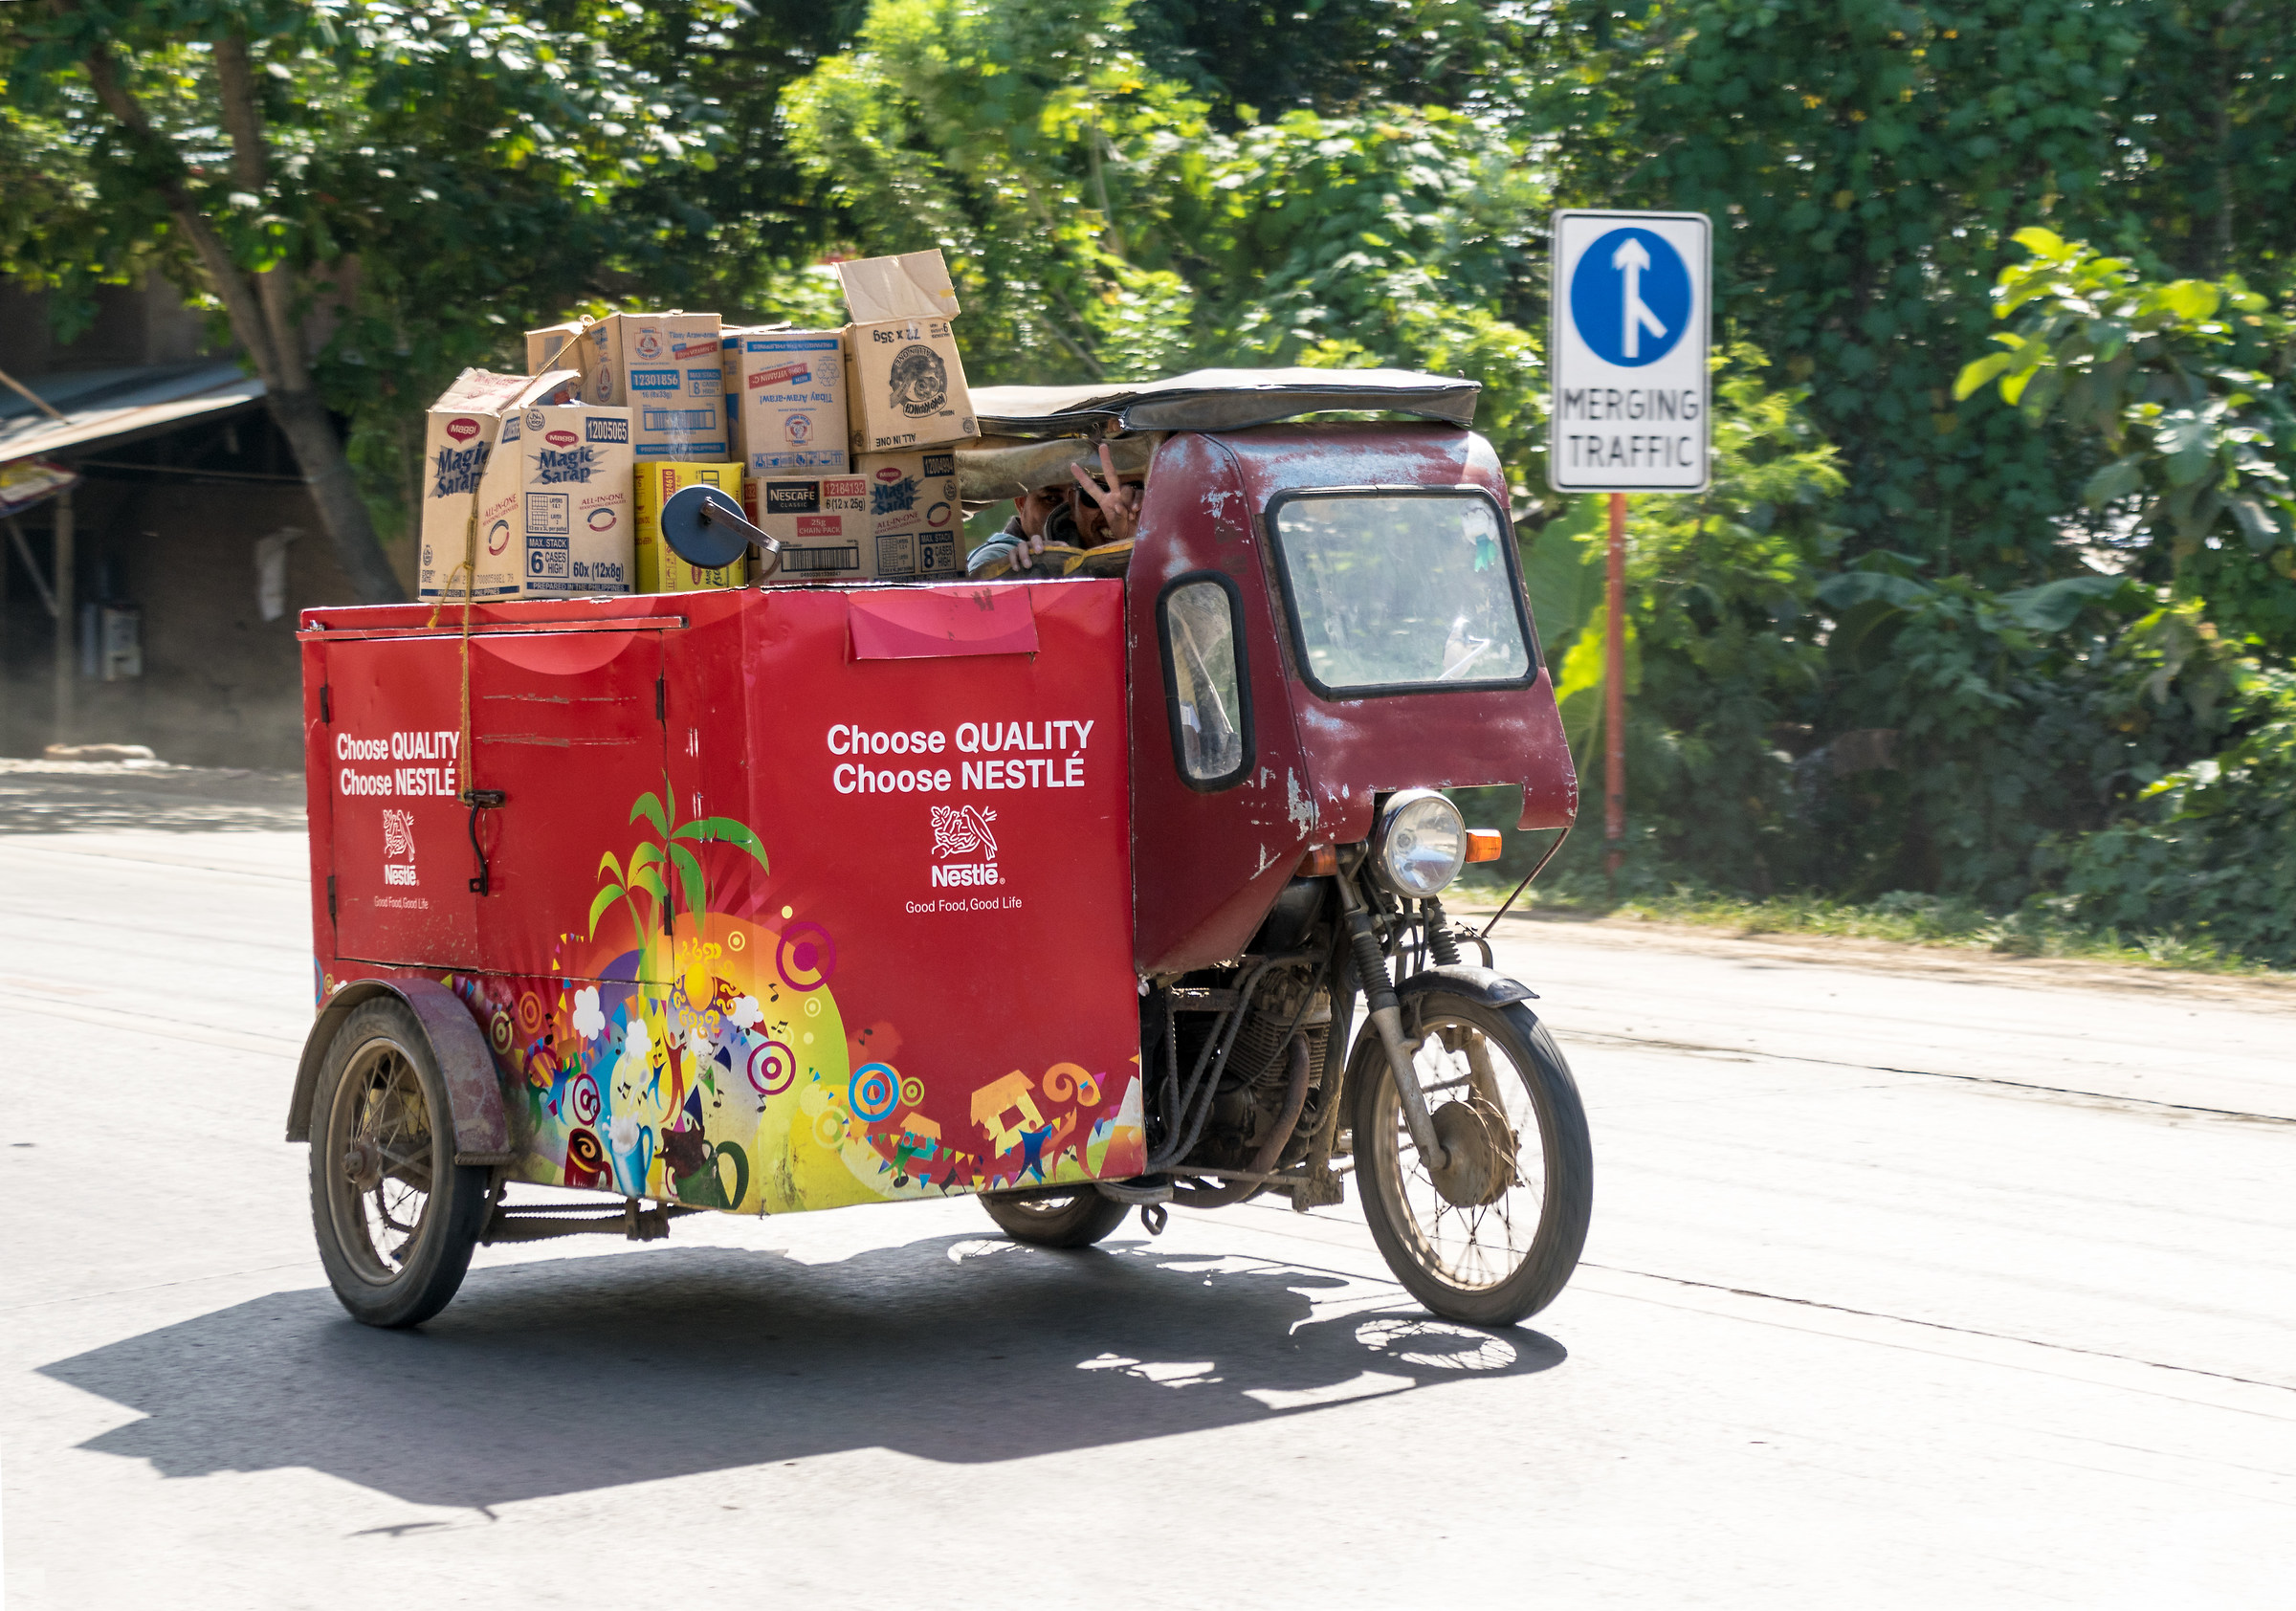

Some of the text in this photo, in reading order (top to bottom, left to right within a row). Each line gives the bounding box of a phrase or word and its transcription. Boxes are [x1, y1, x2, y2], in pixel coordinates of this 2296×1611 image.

[872, 330, 894, 343] 35g
[894, 350, 909, 367] ONE
[918, 347, 932, 357] ALL
[633, 374, 678, 386] 12301856
[761, 369, 787, 383] VITAMIN
[694, 382, 700, 395] 8
[811, 391, 833, 404] Tibay
[1563, 387, 1699, 421] MERGING
[588, 420, 628, 441] 12005065
[875, 433, 916, 448] ALL IN ONE
[539, 446, 594, 470] Magic
[1567, 434, 1694, 468] TRAFFIC
[541, 467, 591, 485] Sarap
[826, 481, 865, 496] 12184132
[874, 476, 916, 500] Magic
[582, 493, 625, 505] ALL-IN-ONE
[850, 497, 866, 512] 25g)
[811, 519, 826, 527] 25g
[877, 512, 918, 530] ALL-IN-ONE
[545, 539, 567, 548] STACK
[935, 532, 953, 542] STACK
[545, 552, 566, 563] CASES
[924, 546, 935, 568] 8
[935, 544, 953, 557] CASES
[531, 551, 543, 574] 6
[548, 563, 563, 574] HIGH
[938, 557, 951, 567] HIGH
[573, 562, 624, 583] 60x (12x8g)
[533, 583, 566, 591] PREPARED
[828, 719, 1095, 756] Choose QUALITY
[337, 731, 460, 761] Choose QUALITY
[341, 761, 455, 796] Choose NESTLÉ
[833, 750, 1085, 794] Choose NESTLÉ
[374, 895, 388, 908] Good
[403, 897, 418, 910] Good
[418, 897, 429, 910] Life
[905, 895, 1023, 913] Good Food, Good Life
